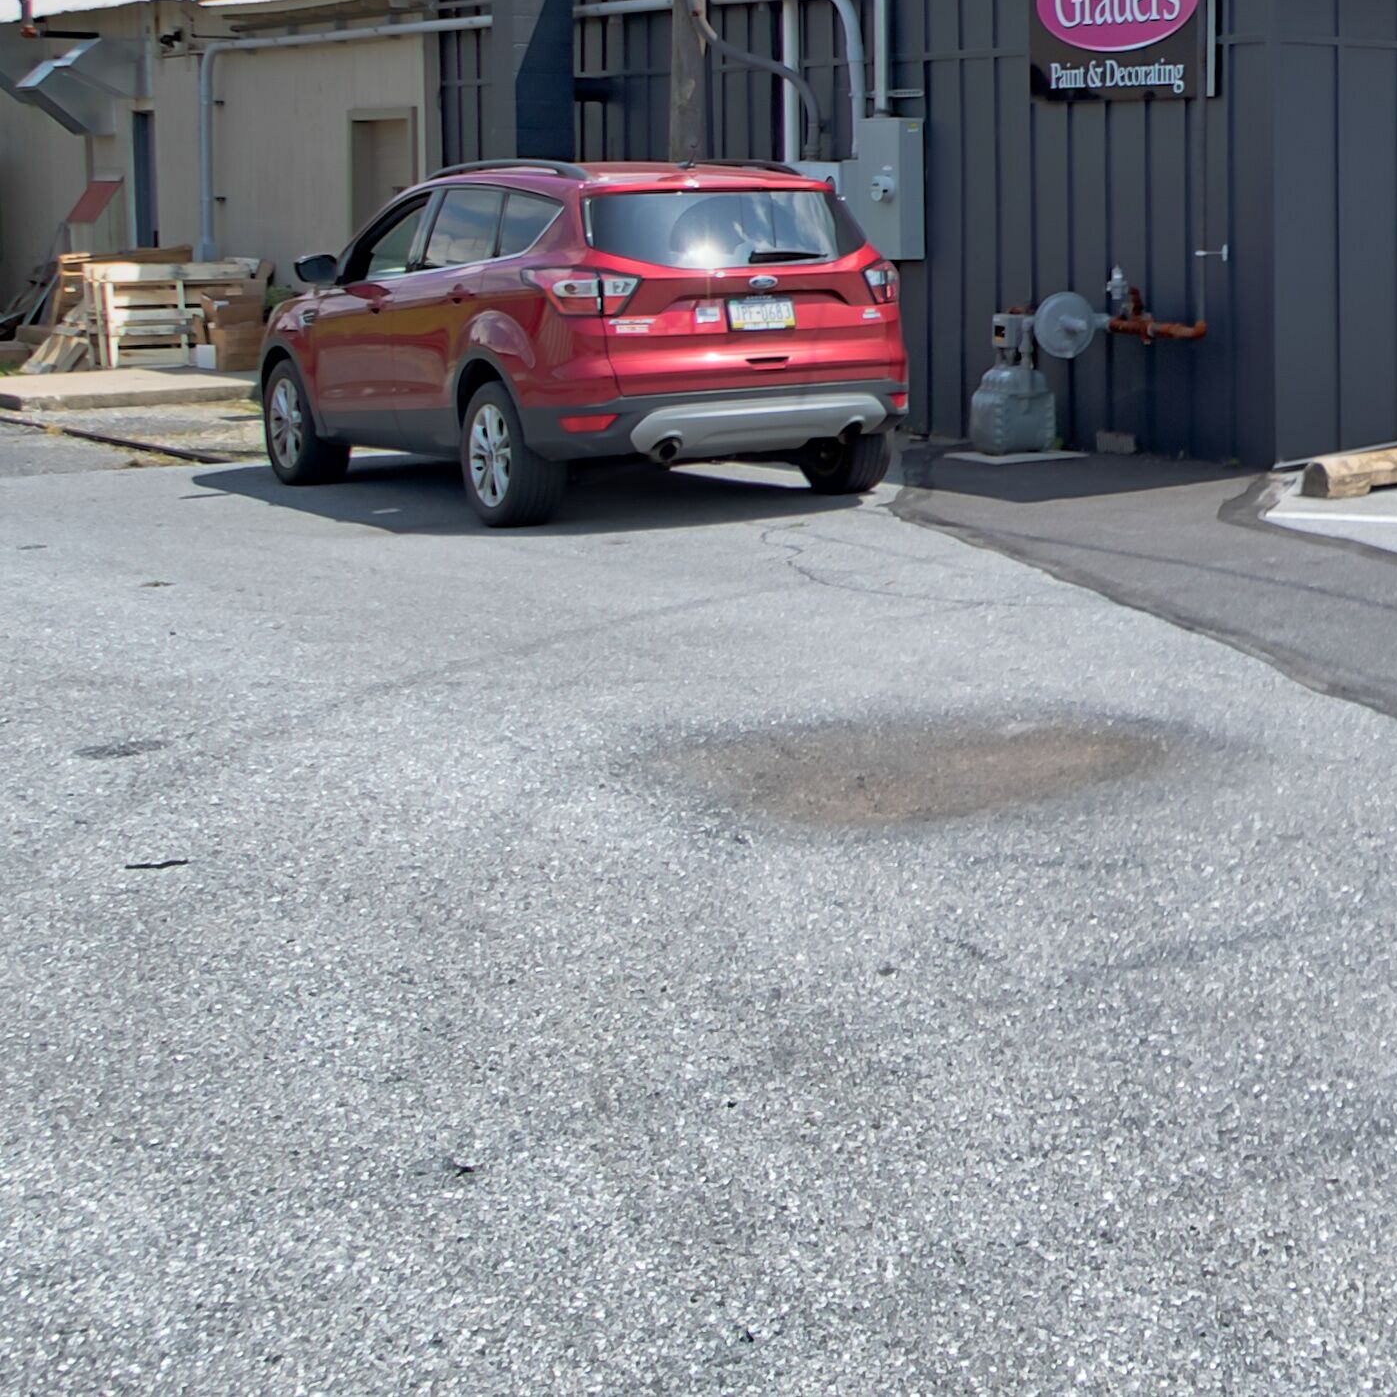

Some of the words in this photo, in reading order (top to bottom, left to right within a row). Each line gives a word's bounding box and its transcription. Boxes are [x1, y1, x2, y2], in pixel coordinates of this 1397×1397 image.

[1050, 63, 1085, 89] Paint
[1087, 60, 1103, 88] &
[1105, 58, 1185, 93] Decorating
